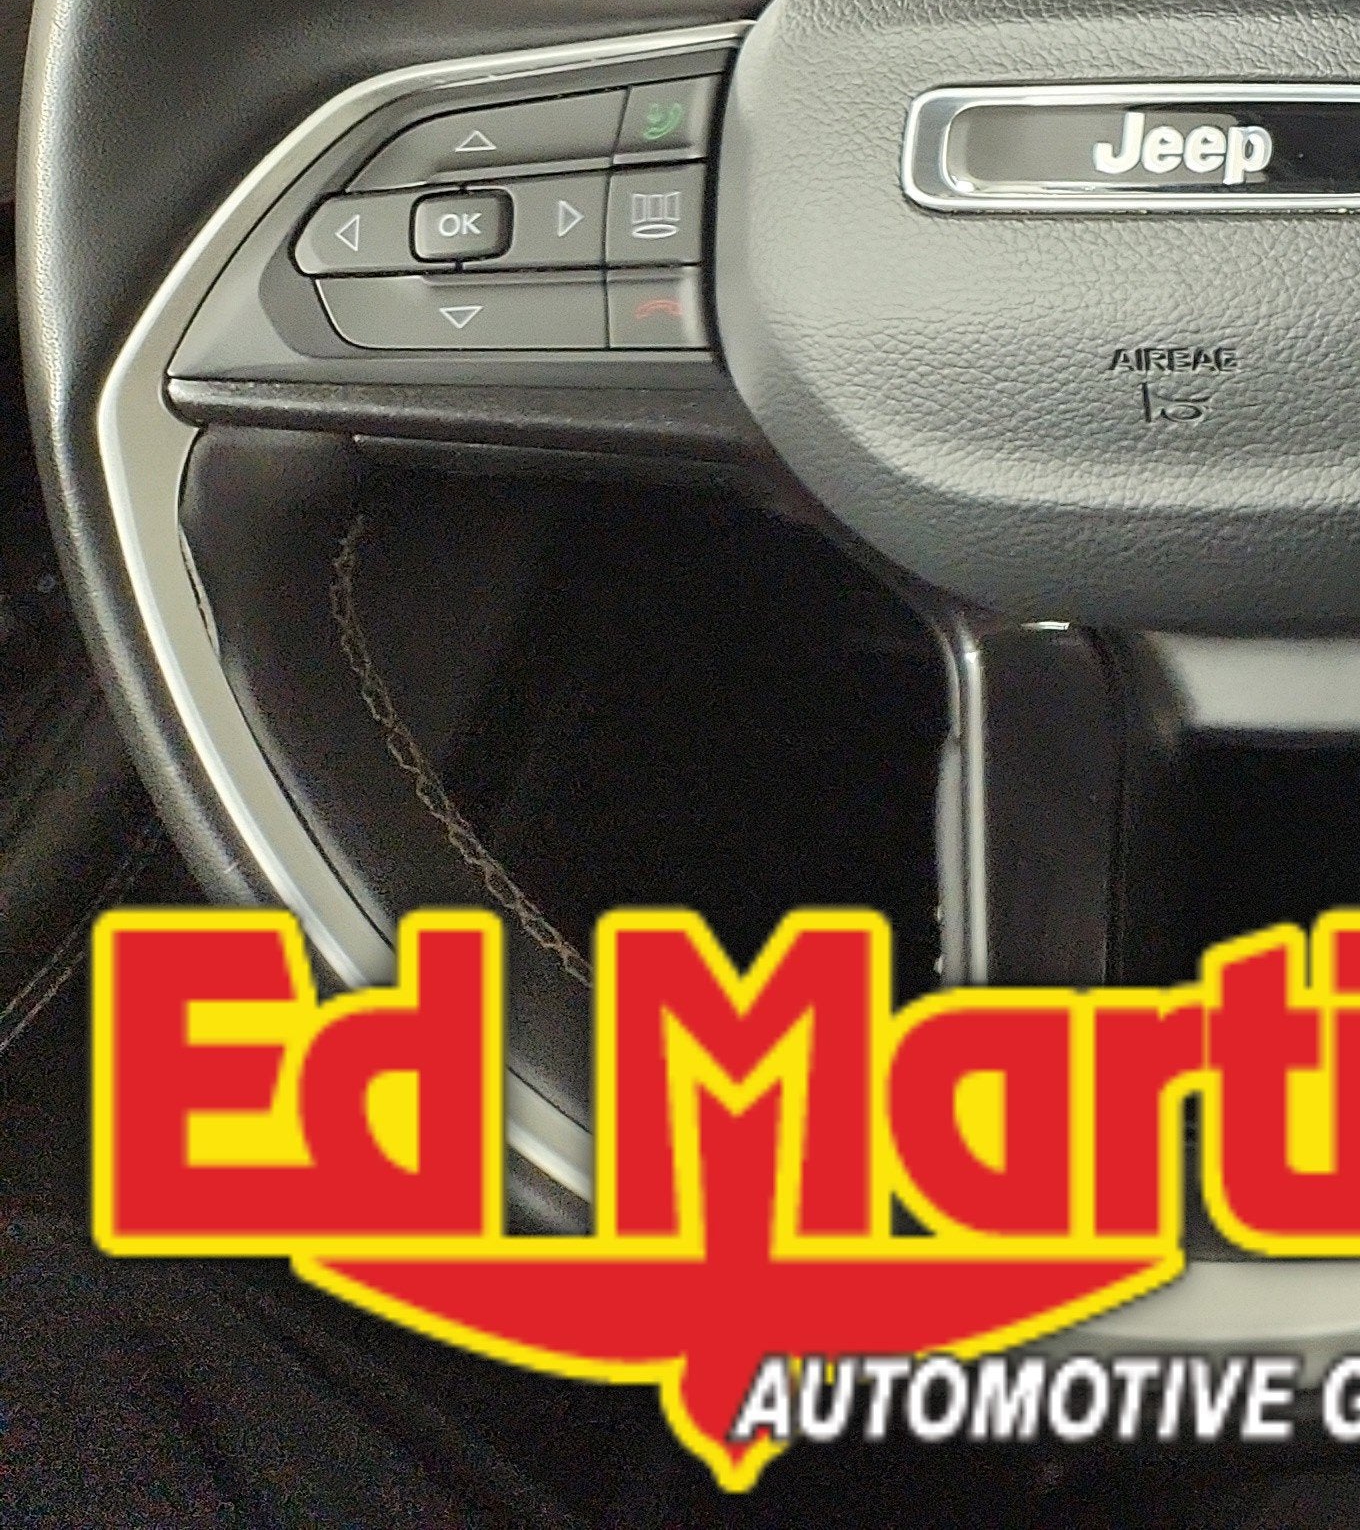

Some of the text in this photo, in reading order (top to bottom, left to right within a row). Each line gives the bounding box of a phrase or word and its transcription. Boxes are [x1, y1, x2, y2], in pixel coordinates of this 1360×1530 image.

[1092, 111, 1273, 185] Jeep
[438, 212, 482, 237] OK
[1108, 347, 1240, 372] AIRBAG
